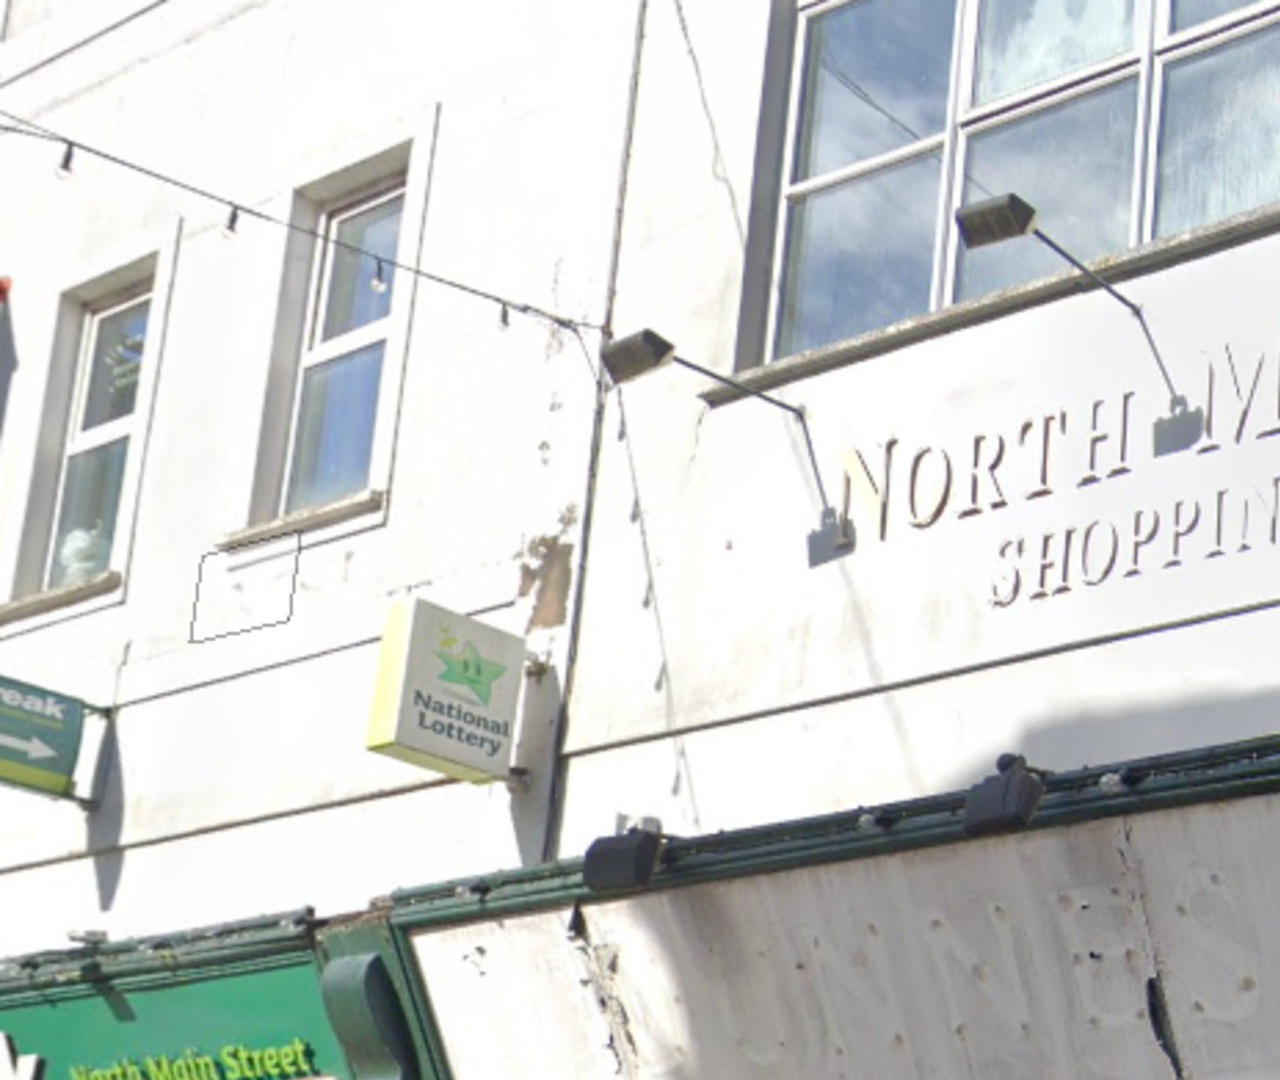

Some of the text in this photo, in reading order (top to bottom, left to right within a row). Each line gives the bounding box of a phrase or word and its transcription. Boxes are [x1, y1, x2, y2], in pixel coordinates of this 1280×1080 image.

[833, 392, 1134, 544] NORTH
[0, 687, 66, 721] eak
[413, 689, 510, 737] National
[418, 711, 502, 757] Lottery
[219, 1037, 312, 1080] Street
